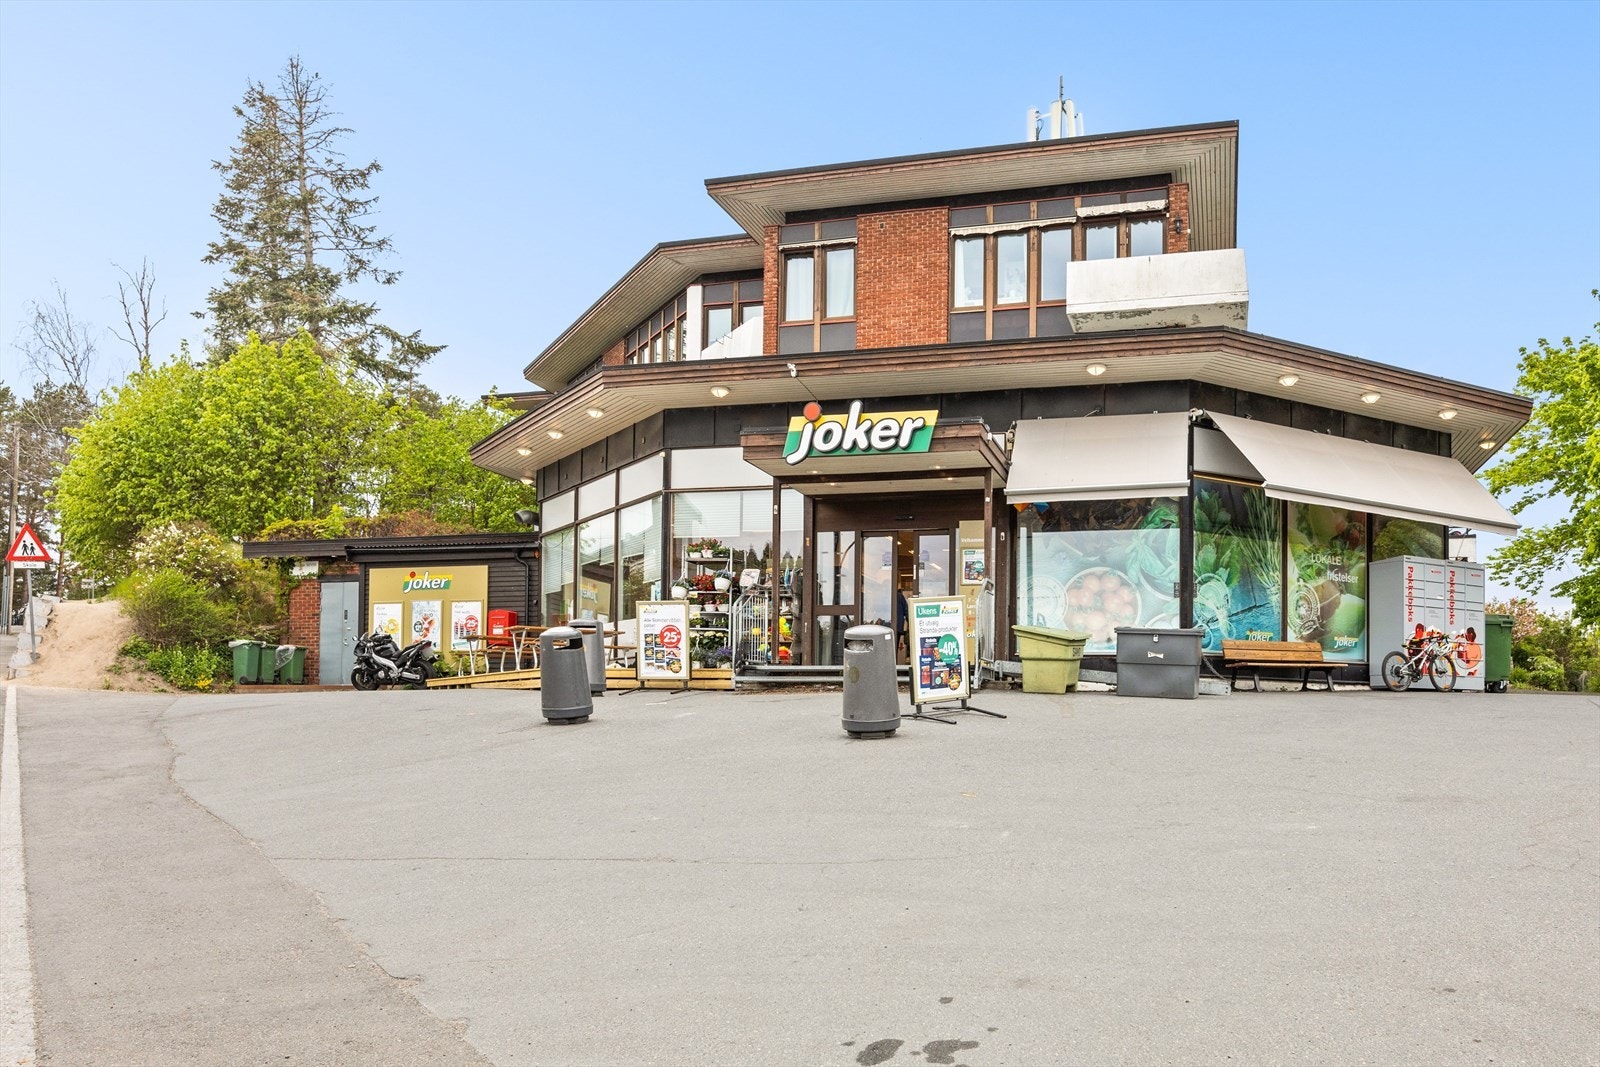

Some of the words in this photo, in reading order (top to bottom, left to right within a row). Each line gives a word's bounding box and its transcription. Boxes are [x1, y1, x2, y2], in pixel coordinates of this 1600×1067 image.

[785, 400, 925, 465] joker
[1311, 553, 1342, 566] LOKALE
[403, 571, 449, 594] joker
[917, 607, 938, 615] Ukens
[1247, 628, 1272, 641] joker
[1334, 633, 1358, 648] joker
